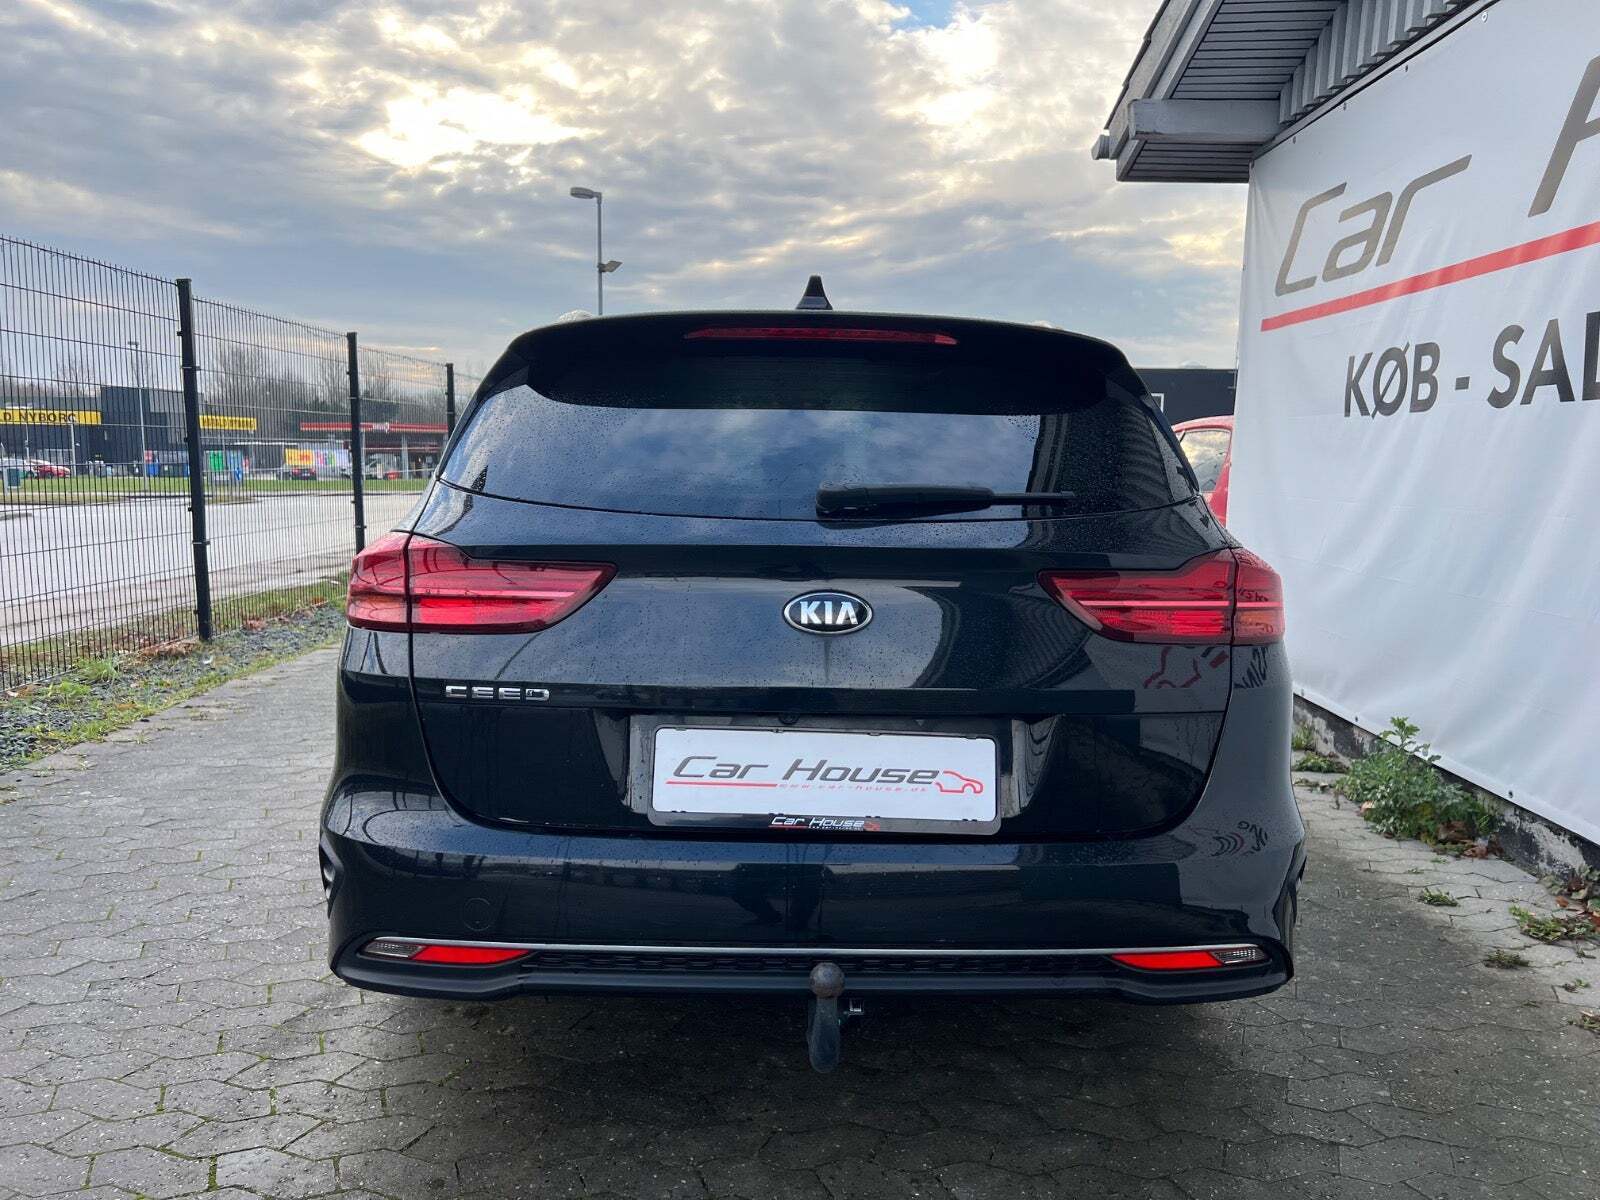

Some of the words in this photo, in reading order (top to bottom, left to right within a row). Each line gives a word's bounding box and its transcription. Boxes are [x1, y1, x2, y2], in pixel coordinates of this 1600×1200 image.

[1275, 154, 1472, 296] Car
[1344, 342, 1440, 419] KØB
[799, 601, 860, 625] KIA
[445, 685, 550, 701] CEED
[673, 756, 769, 779] Car
[782, 758, 940, 784] House
[771, 816, 804, 826] Car
[808, 817, 864, 828] House
